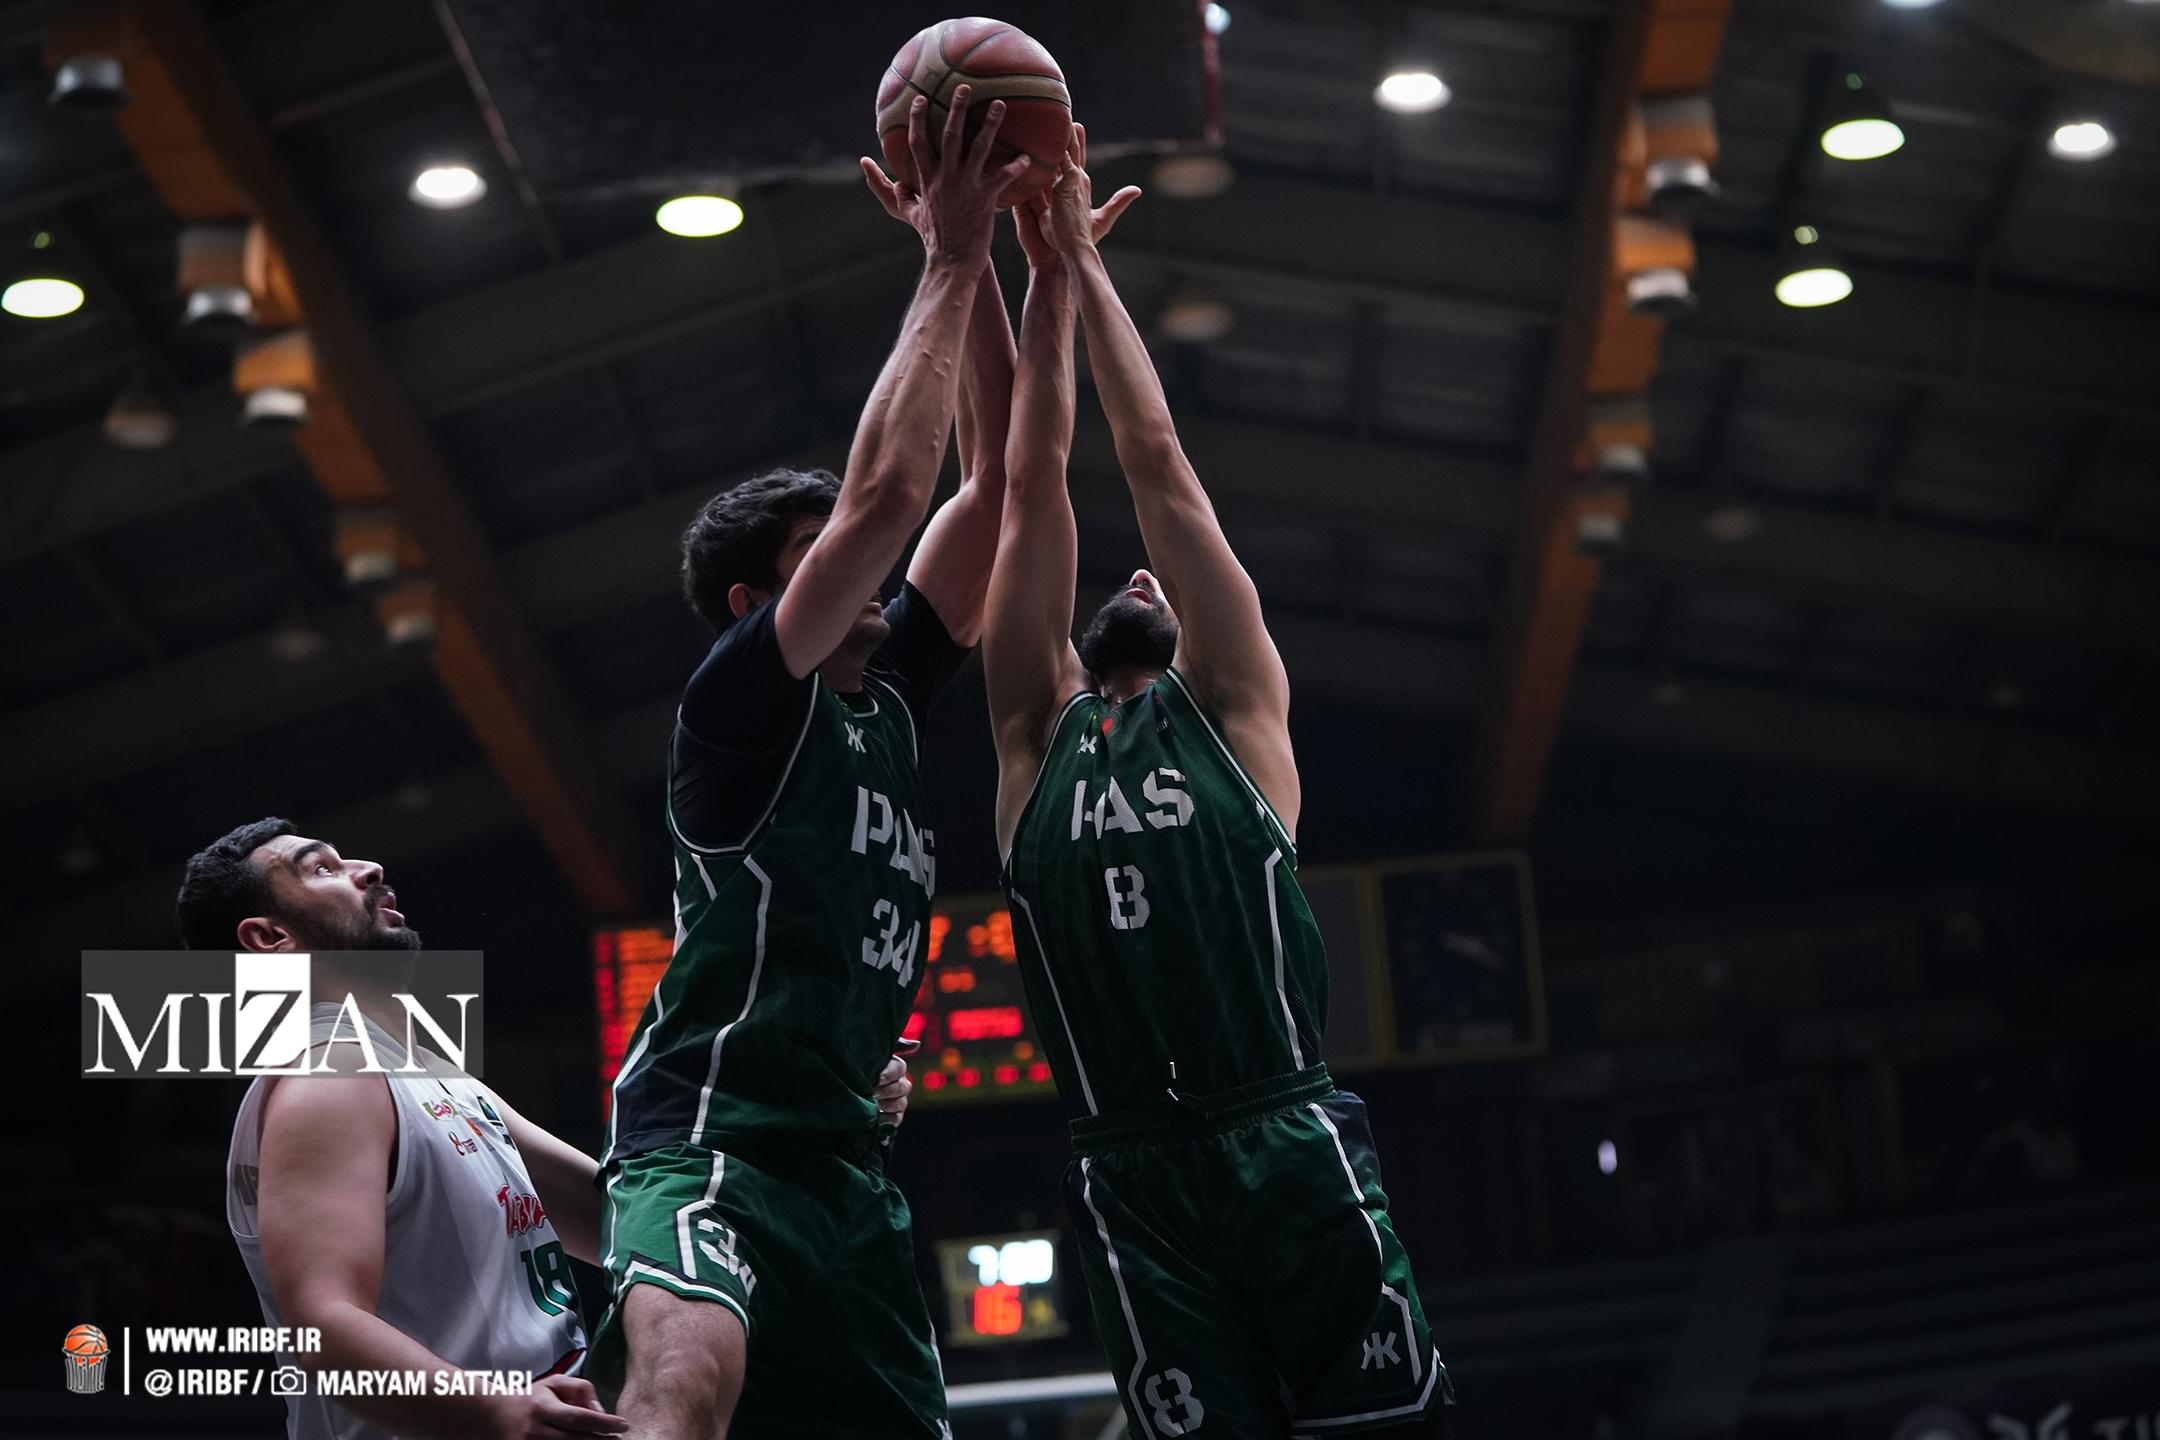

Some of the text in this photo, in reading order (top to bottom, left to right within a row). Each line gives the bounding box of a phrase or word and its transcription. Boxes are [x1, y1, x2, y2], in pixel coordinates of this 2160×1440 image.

[1104, 864, 1150, 930] 8
[861, 898, 921, 989] 34
[520, 1240, 584, 1317] 18
[1144, 1366, 1205, 1439] 8
